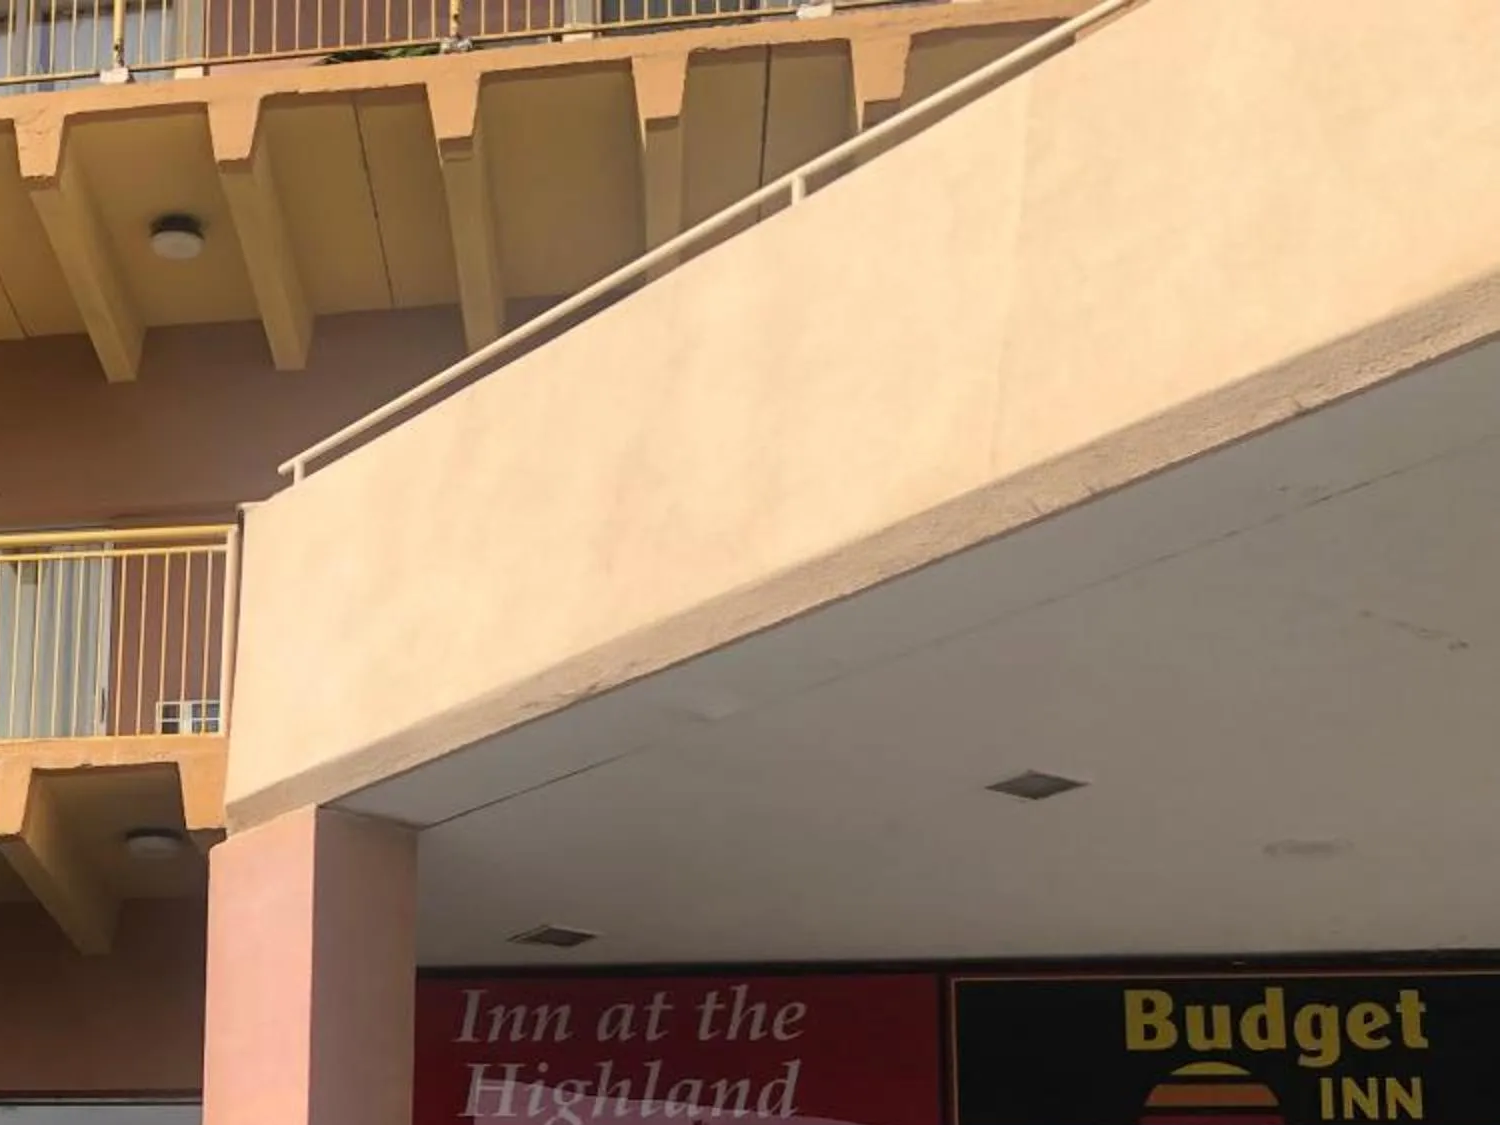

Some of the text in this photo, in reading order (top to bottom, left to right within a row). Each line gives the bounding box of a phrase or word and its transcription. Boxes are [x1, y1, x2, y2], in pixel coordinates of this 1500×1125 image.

[454, 984, 807, 1043] Inn at the
[1123, 986, 1429, 1068] Budget
[1320, 1076, 1423, 1120] INN
